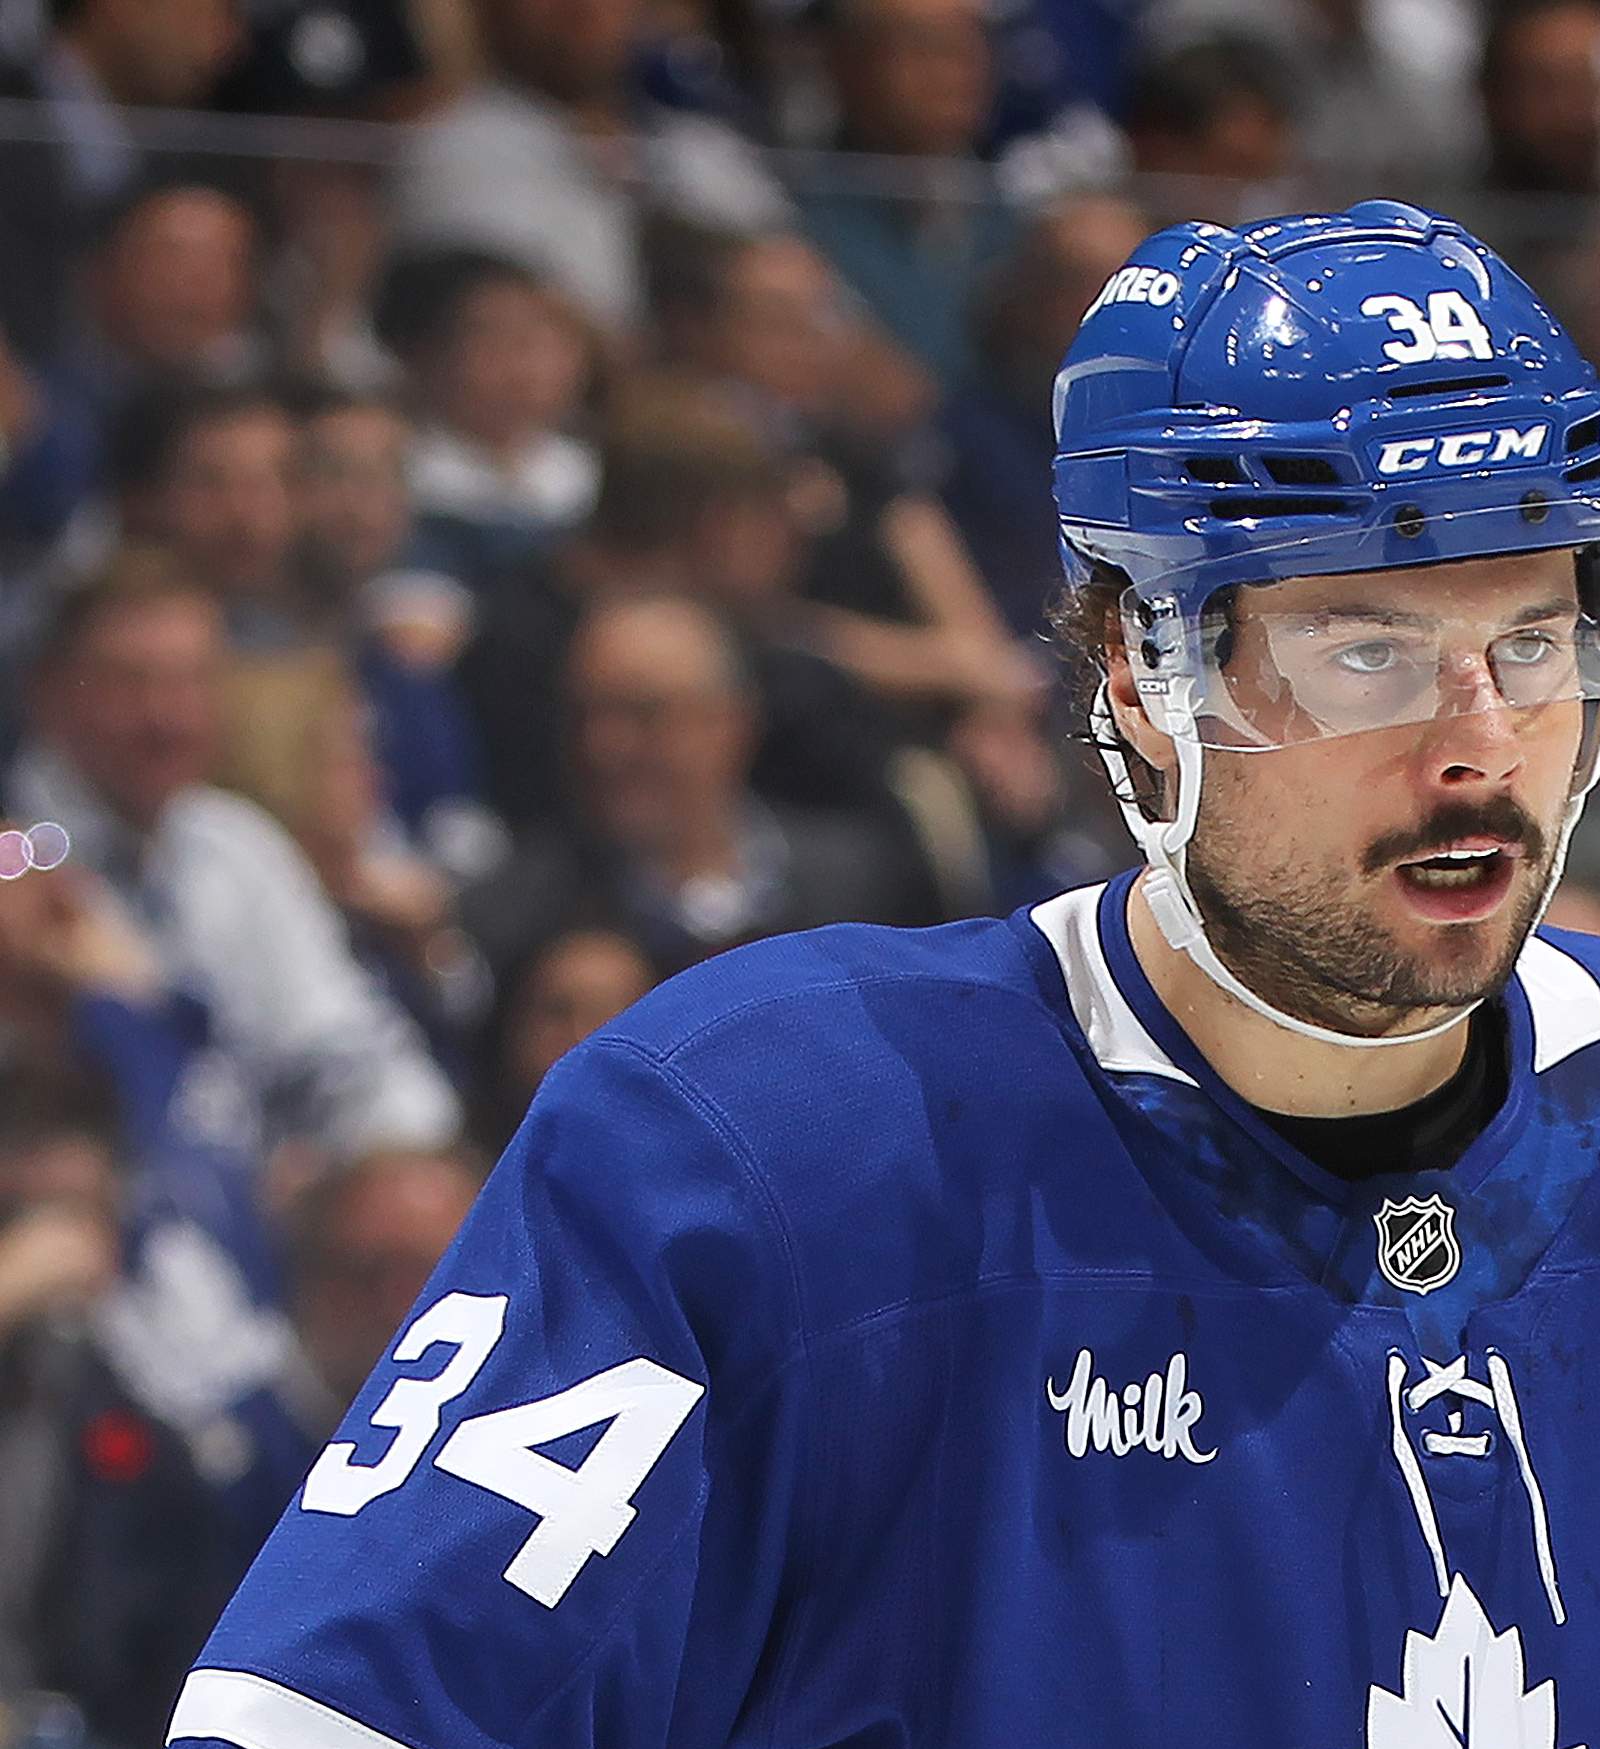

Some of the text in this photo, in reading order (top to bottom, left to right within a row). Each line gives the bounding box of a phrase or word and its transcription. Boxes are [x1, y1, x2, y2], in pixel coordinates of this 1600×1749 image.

[1359, 289, 1494, 364] 34
[1377, 424, 1549, 475] CCM
[1395, 1221, 1440, 1273] NHL
[1048, 1348, 1218, 1463] Milk
[301, 1291, 706, 1611] 34
